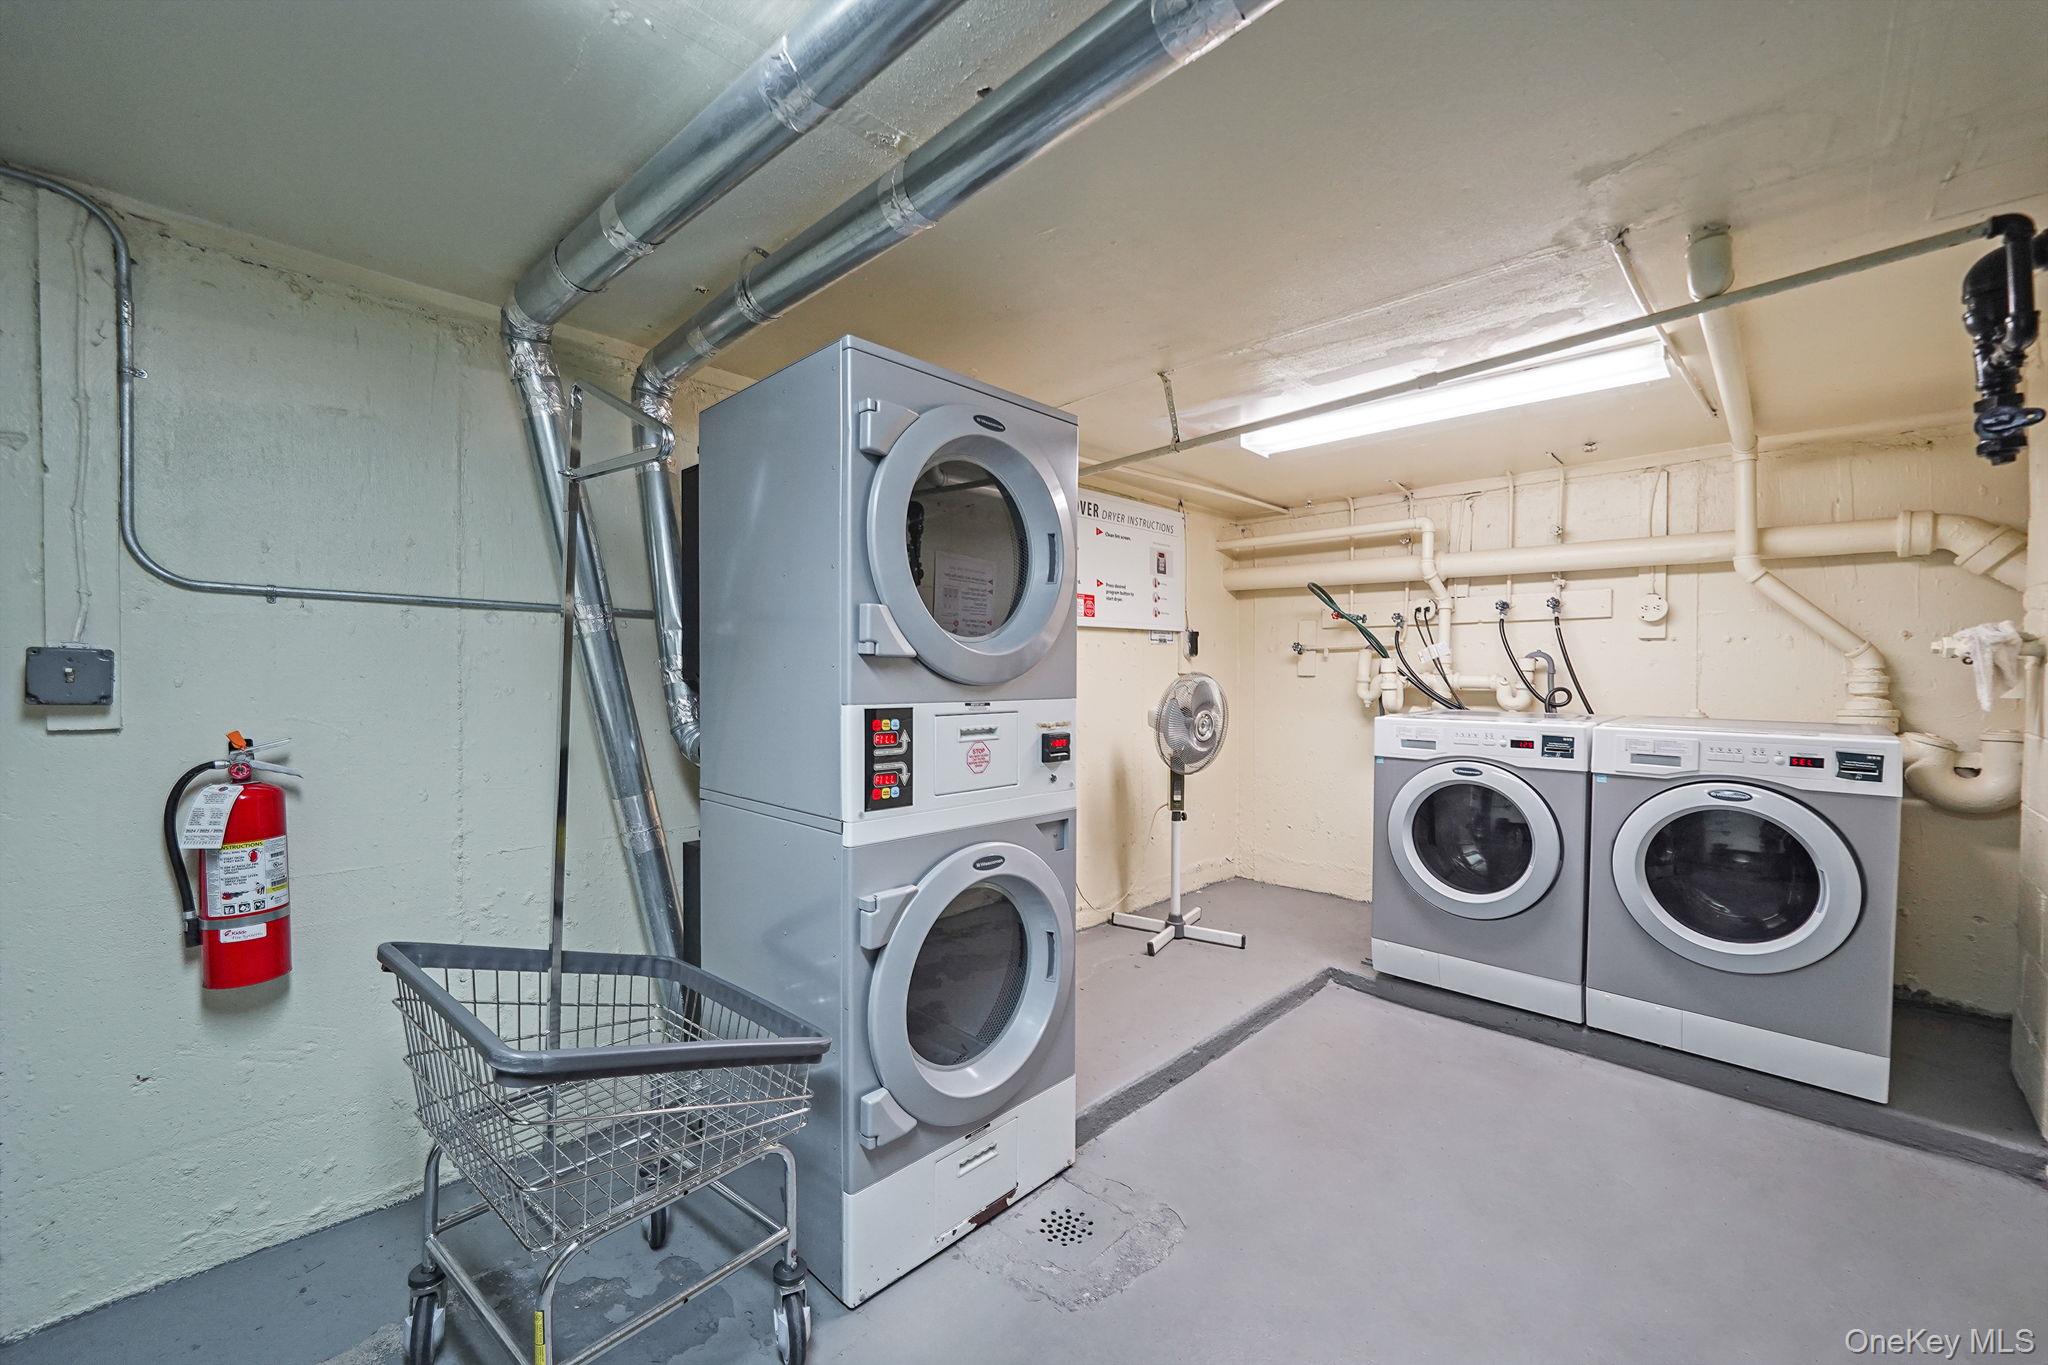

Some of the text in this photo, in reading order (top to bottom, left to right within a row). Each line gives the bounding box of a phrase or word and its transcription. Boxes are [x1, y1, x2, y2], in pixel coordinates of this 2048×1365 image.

[1077, 501, 1174, 534] VER DRYER INSTRUCTIONS
[972, 747, 985, 755] STOP
[222, 841, 263, 850] NSTRUCTIONS
